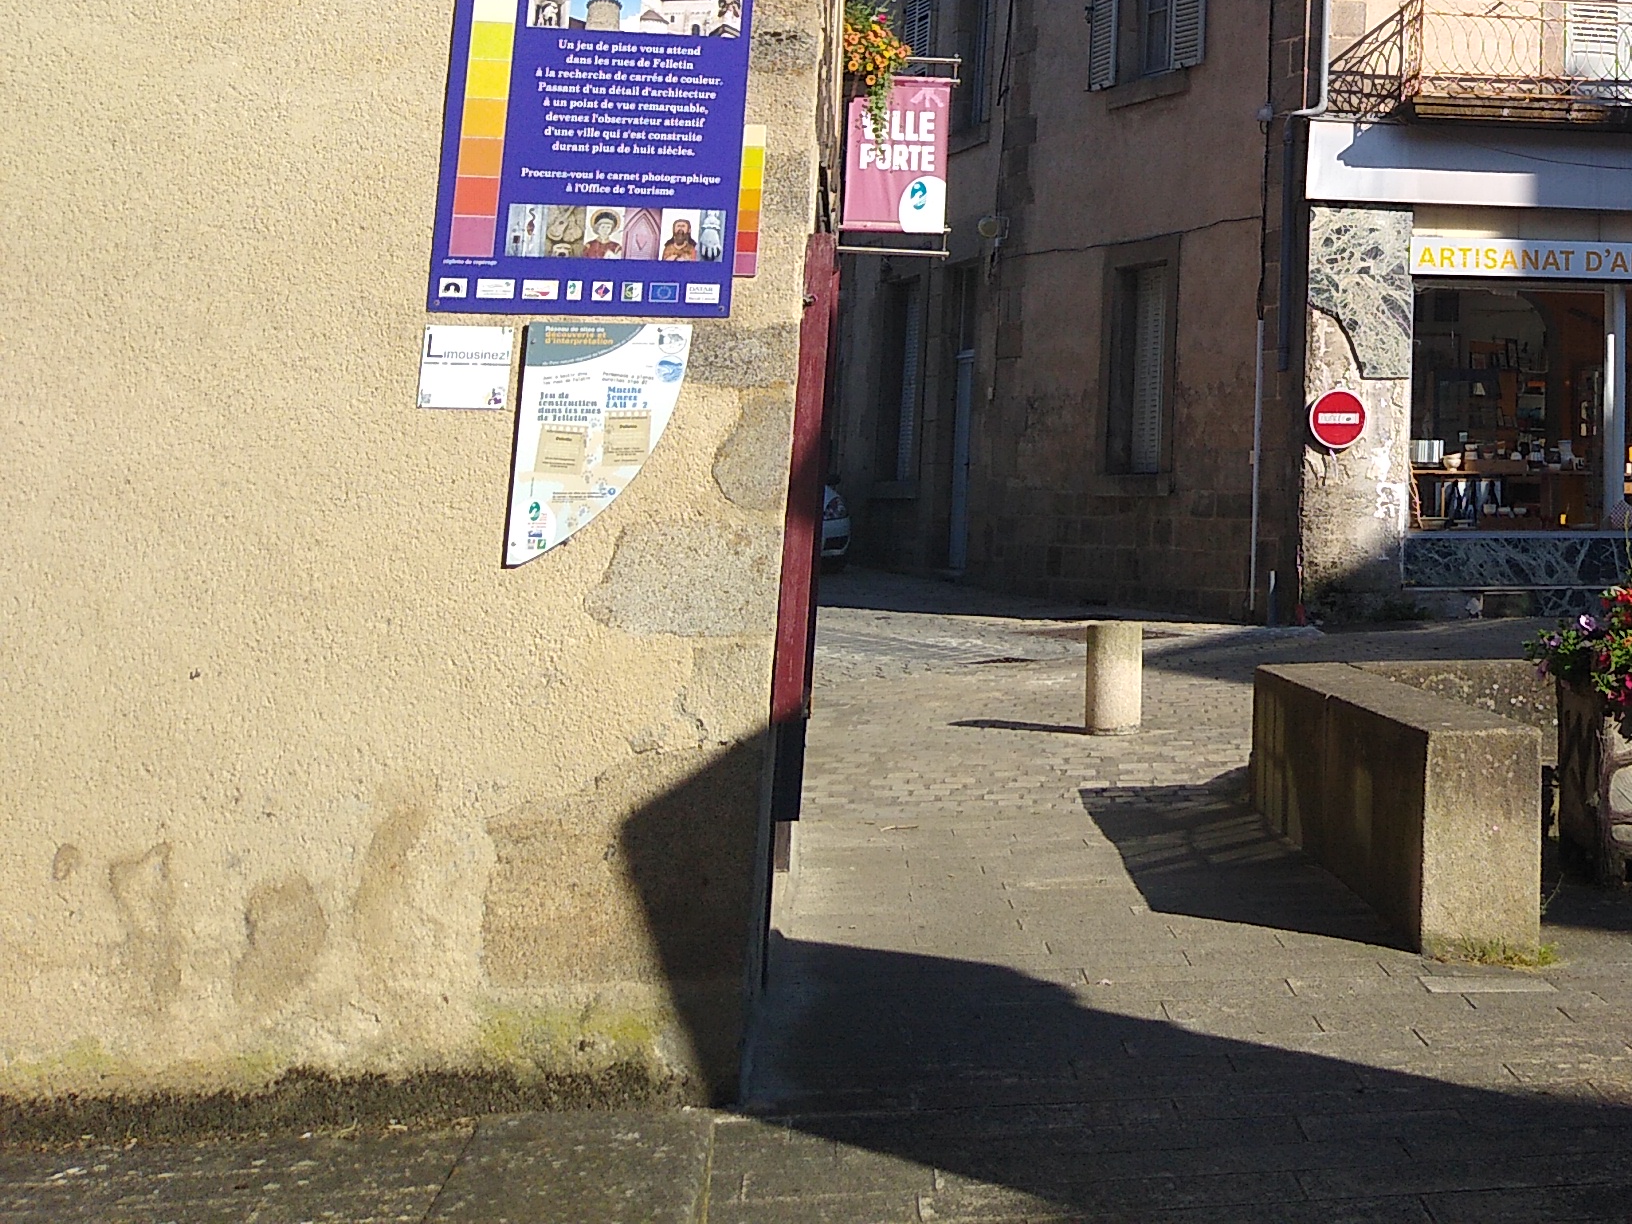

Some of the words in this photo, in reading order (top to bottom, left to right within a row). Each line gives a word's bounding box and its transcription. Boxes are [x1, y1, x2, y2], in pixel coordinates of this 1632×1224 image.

[558, 39, 574, 50] Un
[575, 40, 593, 52] jeu
[596, 41, 609, 51] de
[611, 42, 637, 54] piste
[639, 45, 664, 54] vous
[666, 45, 701, 56] attend
[566, 54, 592, 65] dans
[594, 55, 609, 66] les
[611, 58, 635, 67] rues
[637, 57, 650, 68] de
[652, 58, 694, 70] Felletin
[535, 67, 543, 77] à
[545, 67, 556, 78] la
[557, 69, 611, 81] recherche
[614, 71, 627, 81] de
[629, 72, 663, 83] carrés
[665, 73, 678, 83] de
[538, 82, 580, 93] Passant
[583, 84, 606, 95] d'un
[608, 85, 640, 96] détail
[641, 87, 717, 99] d'architecture
[543, 97, 550, 107] à
[570, 100, 599, 111] point
[600, 99, 614, 109] de
[616, 102, 636, 110] vue
[638, 102, 709, 114] remarquable,
[545, 112, 590, 123] devenez
[591, 113, 662, 126] l'observateur
[663, 116, 706, 128] attentif
[544, 126, 574, 137] d'une
[576, 128, 601, 138] ville
[602, 129, 621, 141] qui
[622, 130, 646, 140] s'est
[648, 131, 703, 142] construite
[552, 141, 590, 153] durant
[591, 143, 615, 154] plus
[617, 143, 631, 154] de
[632, 144, 655, 155] huit
[657, 145, 696, 157] siècles.
[859, 143, 935, 172] PORTE
[521, 167, 594, 180] Procurez-vous
[595, 170, 605, 180] le
[606, 171, 640, 182] carnet
[641, 172, 721, 185] photographique
[574, 183, 611, 194] l'Office
[612, 184, 625, 194] de
[627, 185, 675, 196] Tourisme
[1418, 246, 1575, 271] ARTISANAT
[426, 334, 510, 360] Limousinez!
